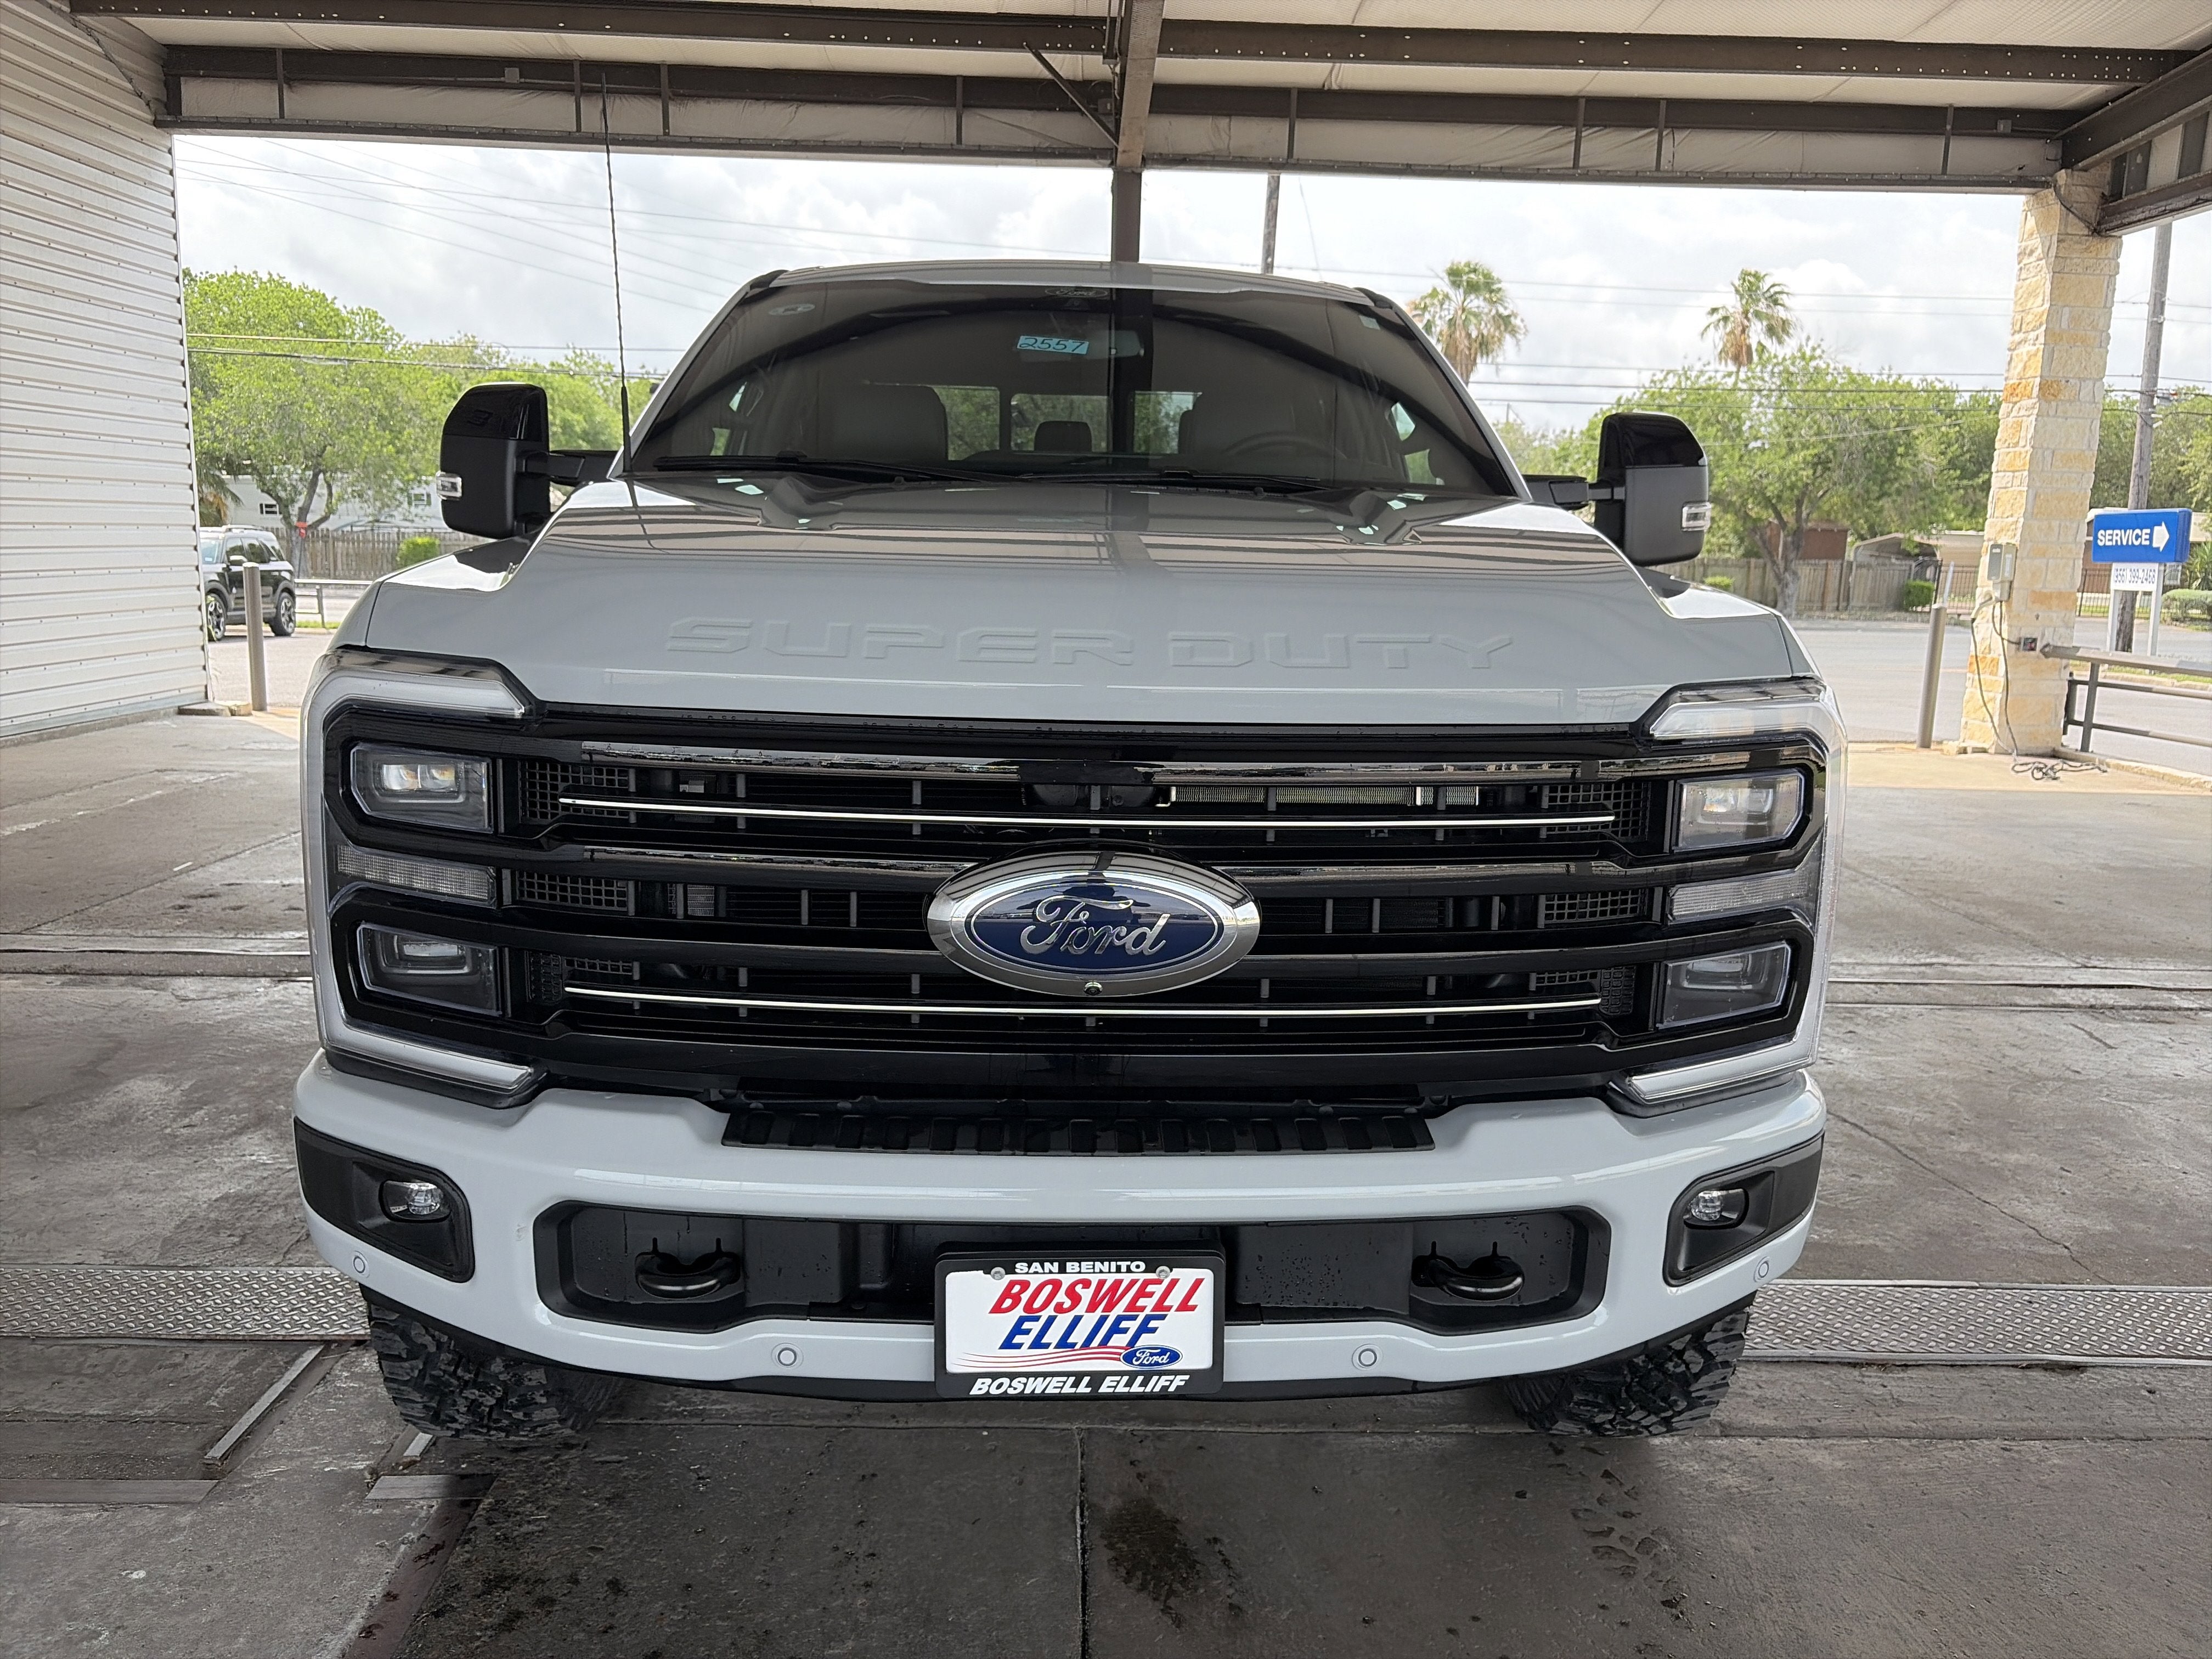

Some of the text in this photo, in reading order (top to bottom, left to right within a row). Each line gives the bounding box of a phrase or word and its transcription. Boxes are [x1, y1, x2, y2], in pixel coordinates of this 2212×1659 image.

[1019, 337, 1085, 352] 2557
[2097, 528, 2151, 546] SERVICE
[2114, 568, 2156, 584] (956) 399-2468
[665, 617, 1514, 669] SUPER DUTY
[1020, 895, 1171, 956] Ford
[1014, 1261, 1146, 1274] SAN BENITO
[988, 1277, 1205, 1314] BOSWELL
[998, 1314, 1169, 1350] ELLIFF
[1132, 1347, 1170, 1365] Ford
[969, 1375, 1190, 1395] BOSWELL ELLIFF
